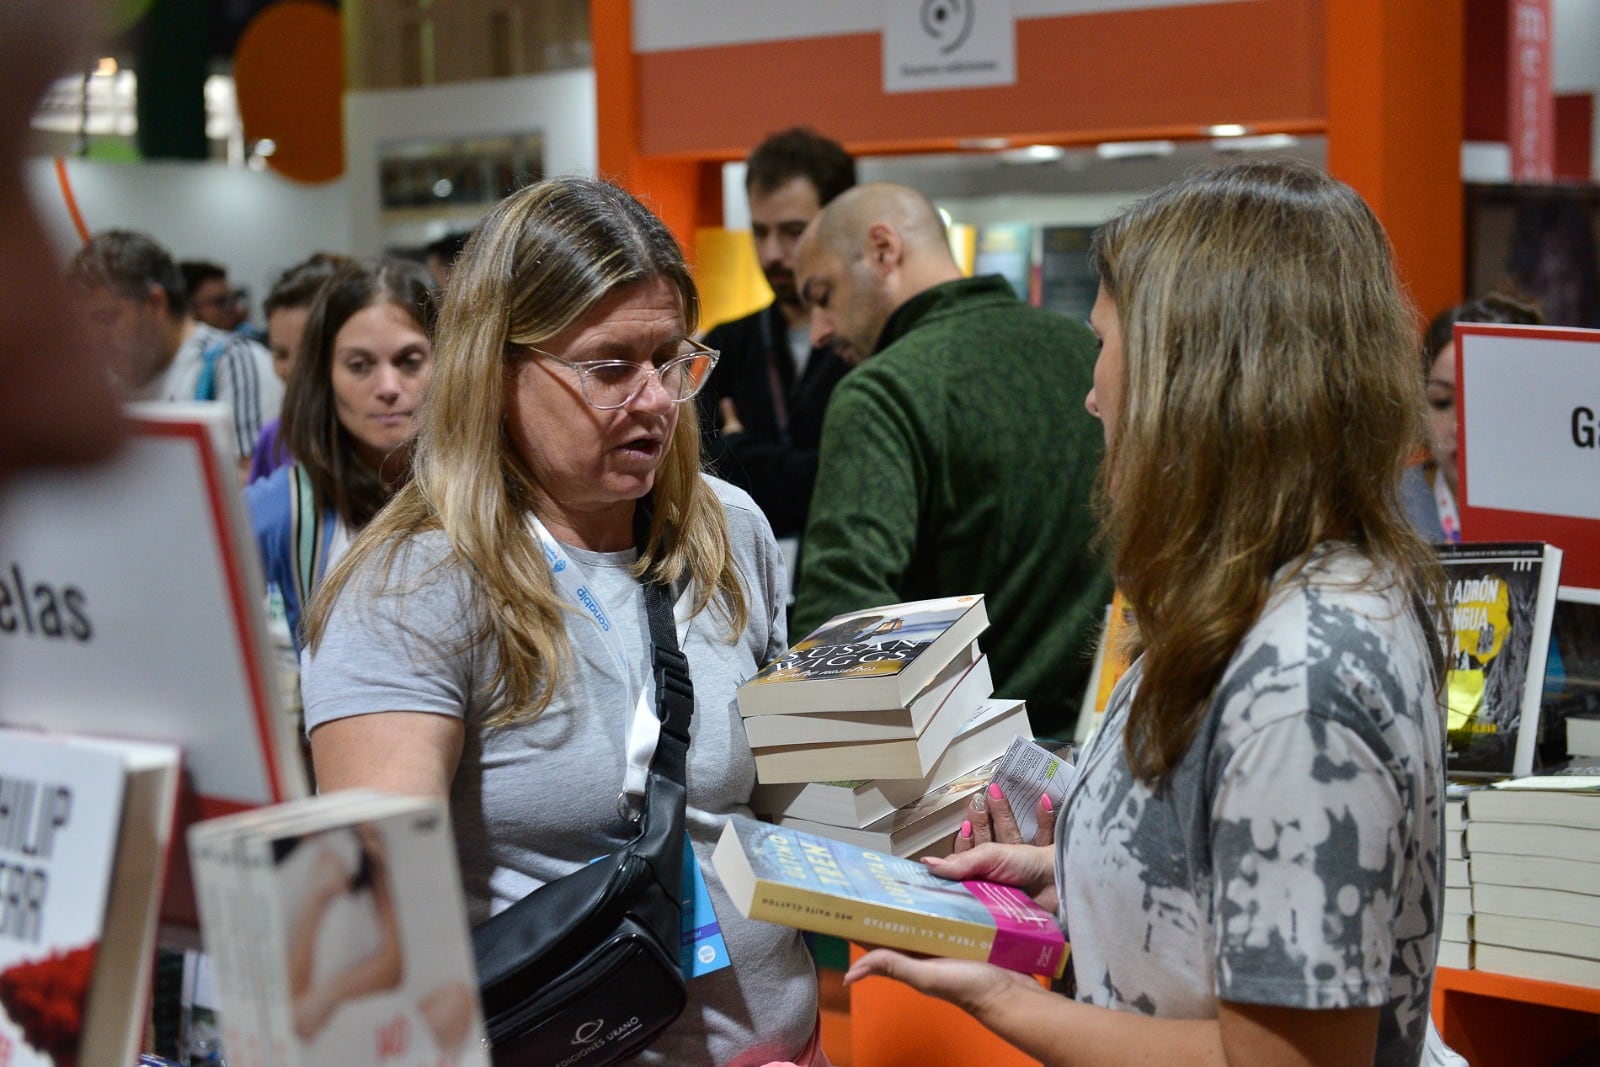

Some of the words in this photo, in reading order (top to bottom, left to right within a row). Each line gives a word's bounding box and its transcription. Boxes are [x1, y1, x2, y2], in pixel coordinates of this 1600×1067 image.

[1571, 405, 1600, 449] G
[576, 585, 610, 632] conabip
[775, 650, 912, 671] WIGGS
[782, 638, 923, 662] SUSAN
[863, 917, 917, 935] LIBERTAD
[920, 929, 934, 939] LA
[606, 1016, 640, 1041] URANO
